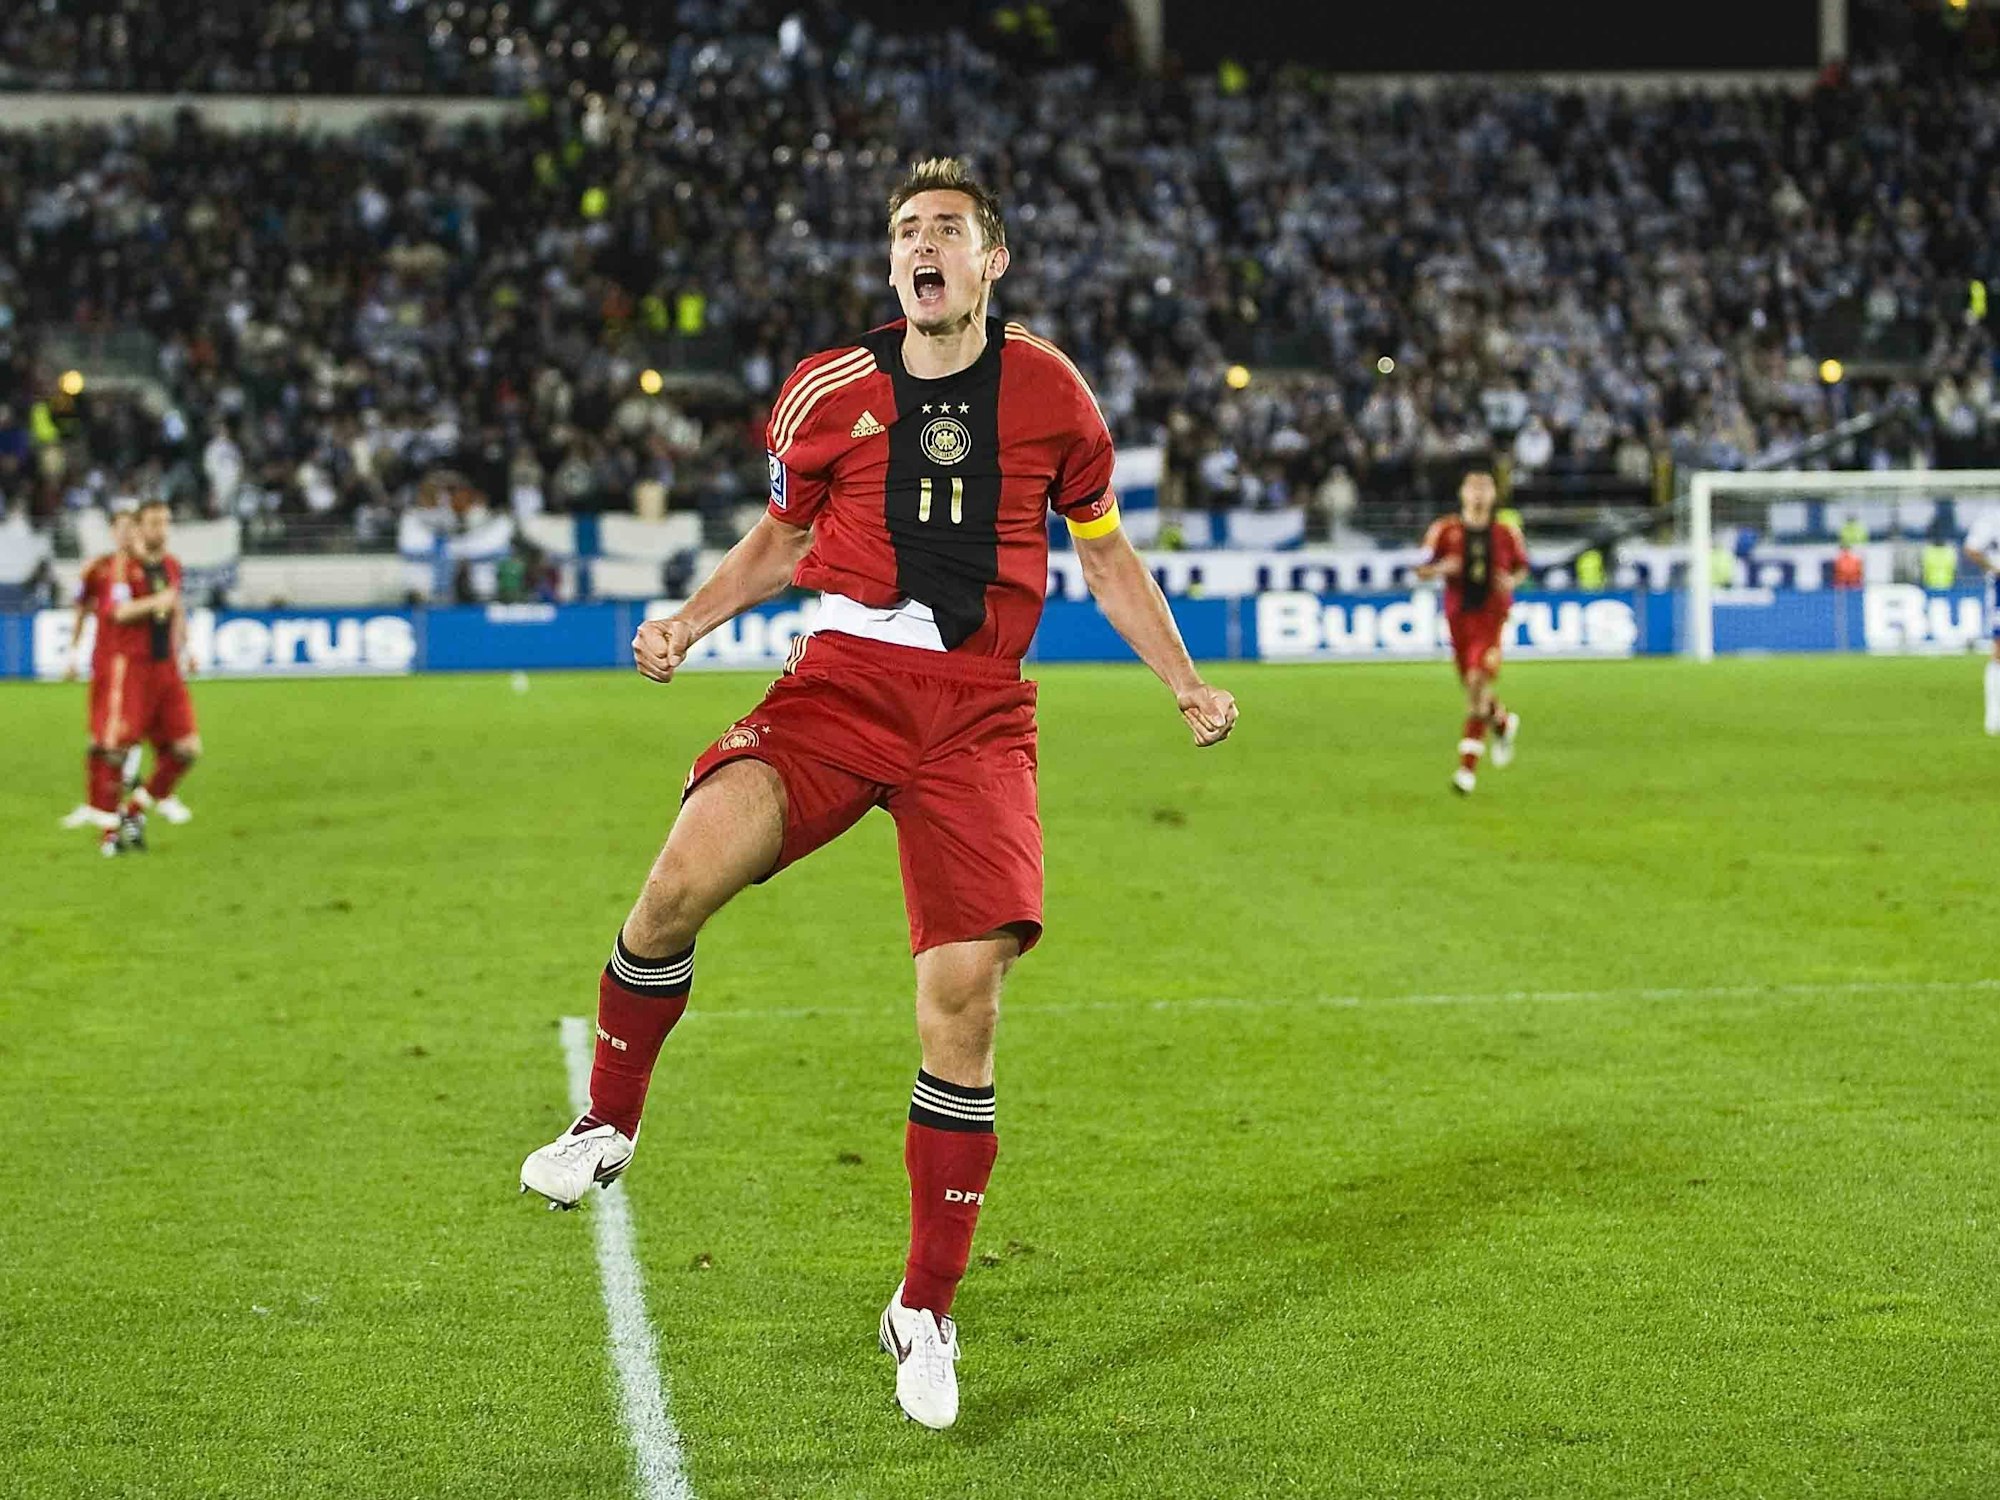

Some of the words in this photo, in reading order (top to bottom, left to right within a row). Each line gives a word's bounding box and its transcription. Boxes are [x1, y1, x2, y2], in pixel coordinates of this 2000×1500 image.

[851, 424, 886, 438] adidas
[919, 477, 963, 524] 11
[1257, 588, 1637, 653] Budrus
